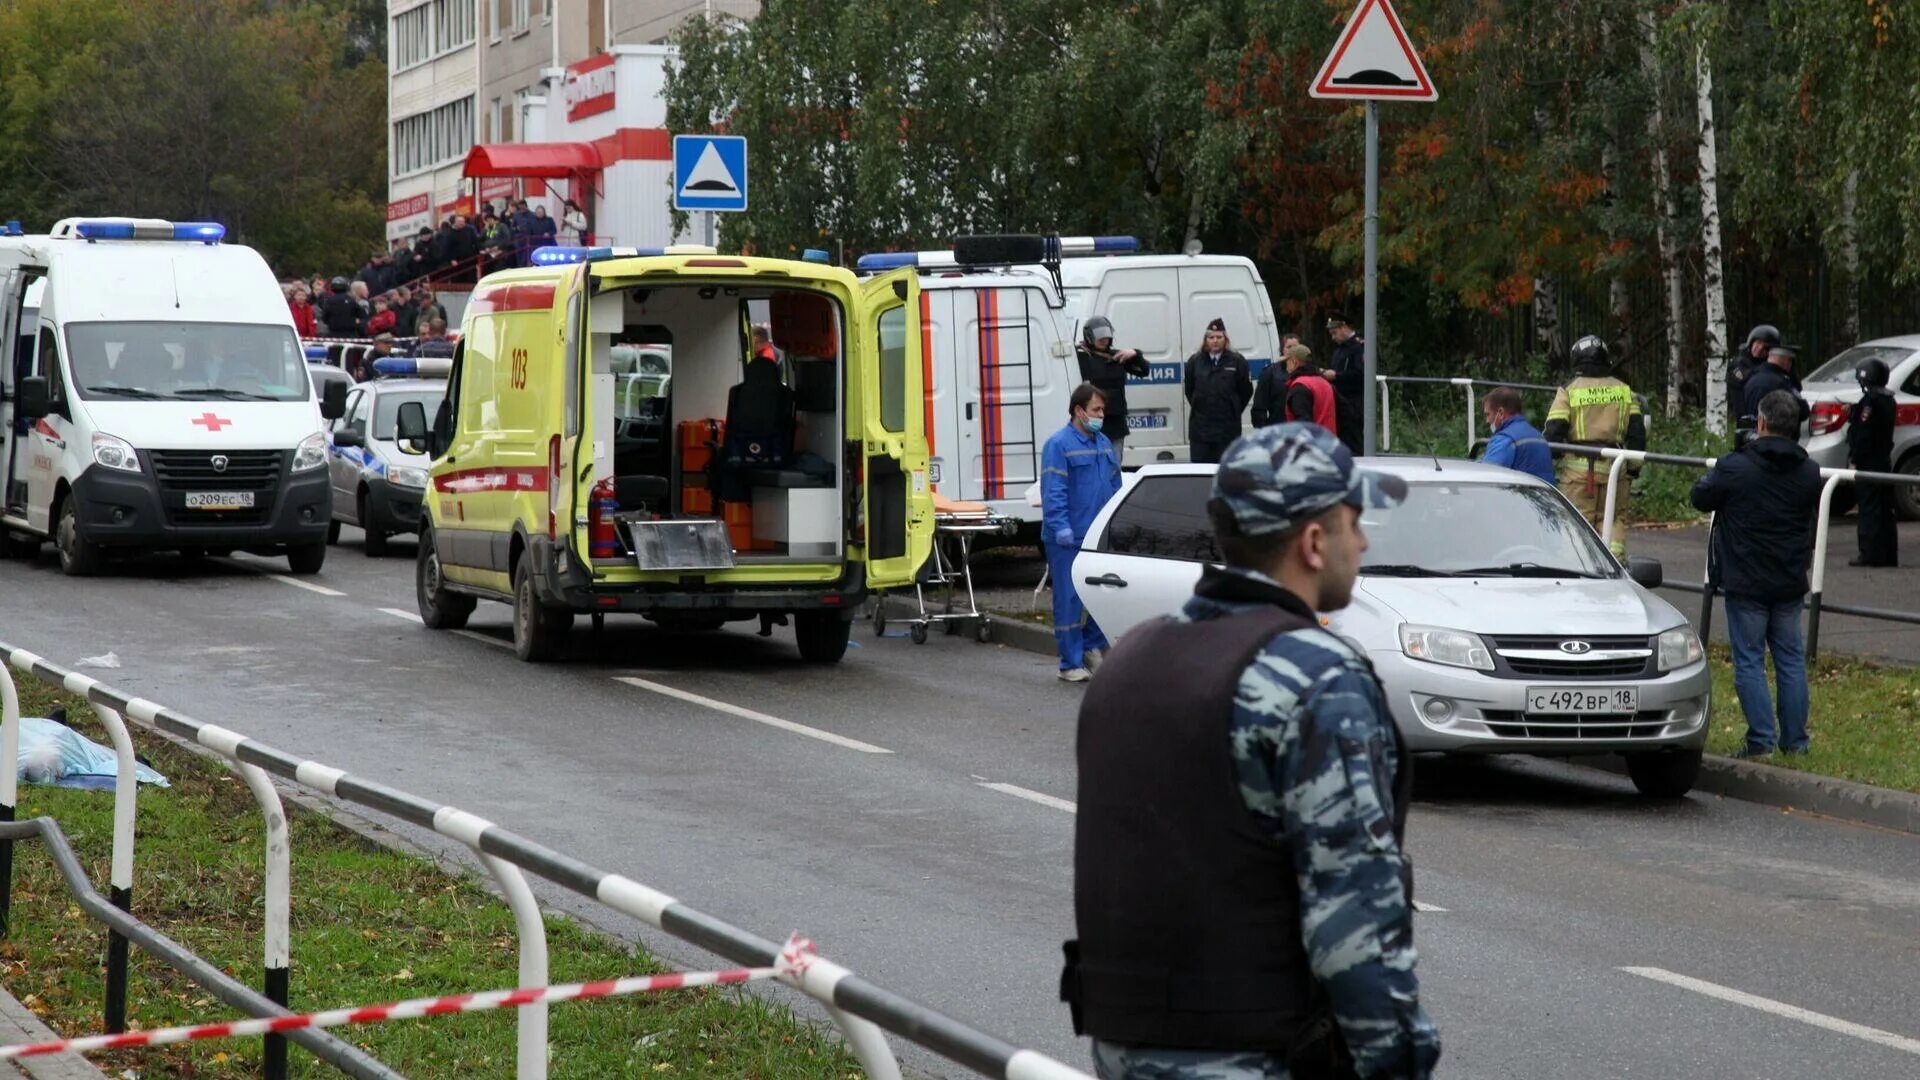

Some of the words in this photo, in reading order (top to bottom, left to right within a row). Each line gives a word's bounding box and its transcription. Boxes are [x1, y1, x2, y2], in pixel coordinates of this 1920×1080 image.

[511, 347, 528, 390] 103
[1588, 387, 1612, 395] МЧС
[1579, 395, 1625, 405] РОССИИ
[1614, 690, 1631, 704] 18
